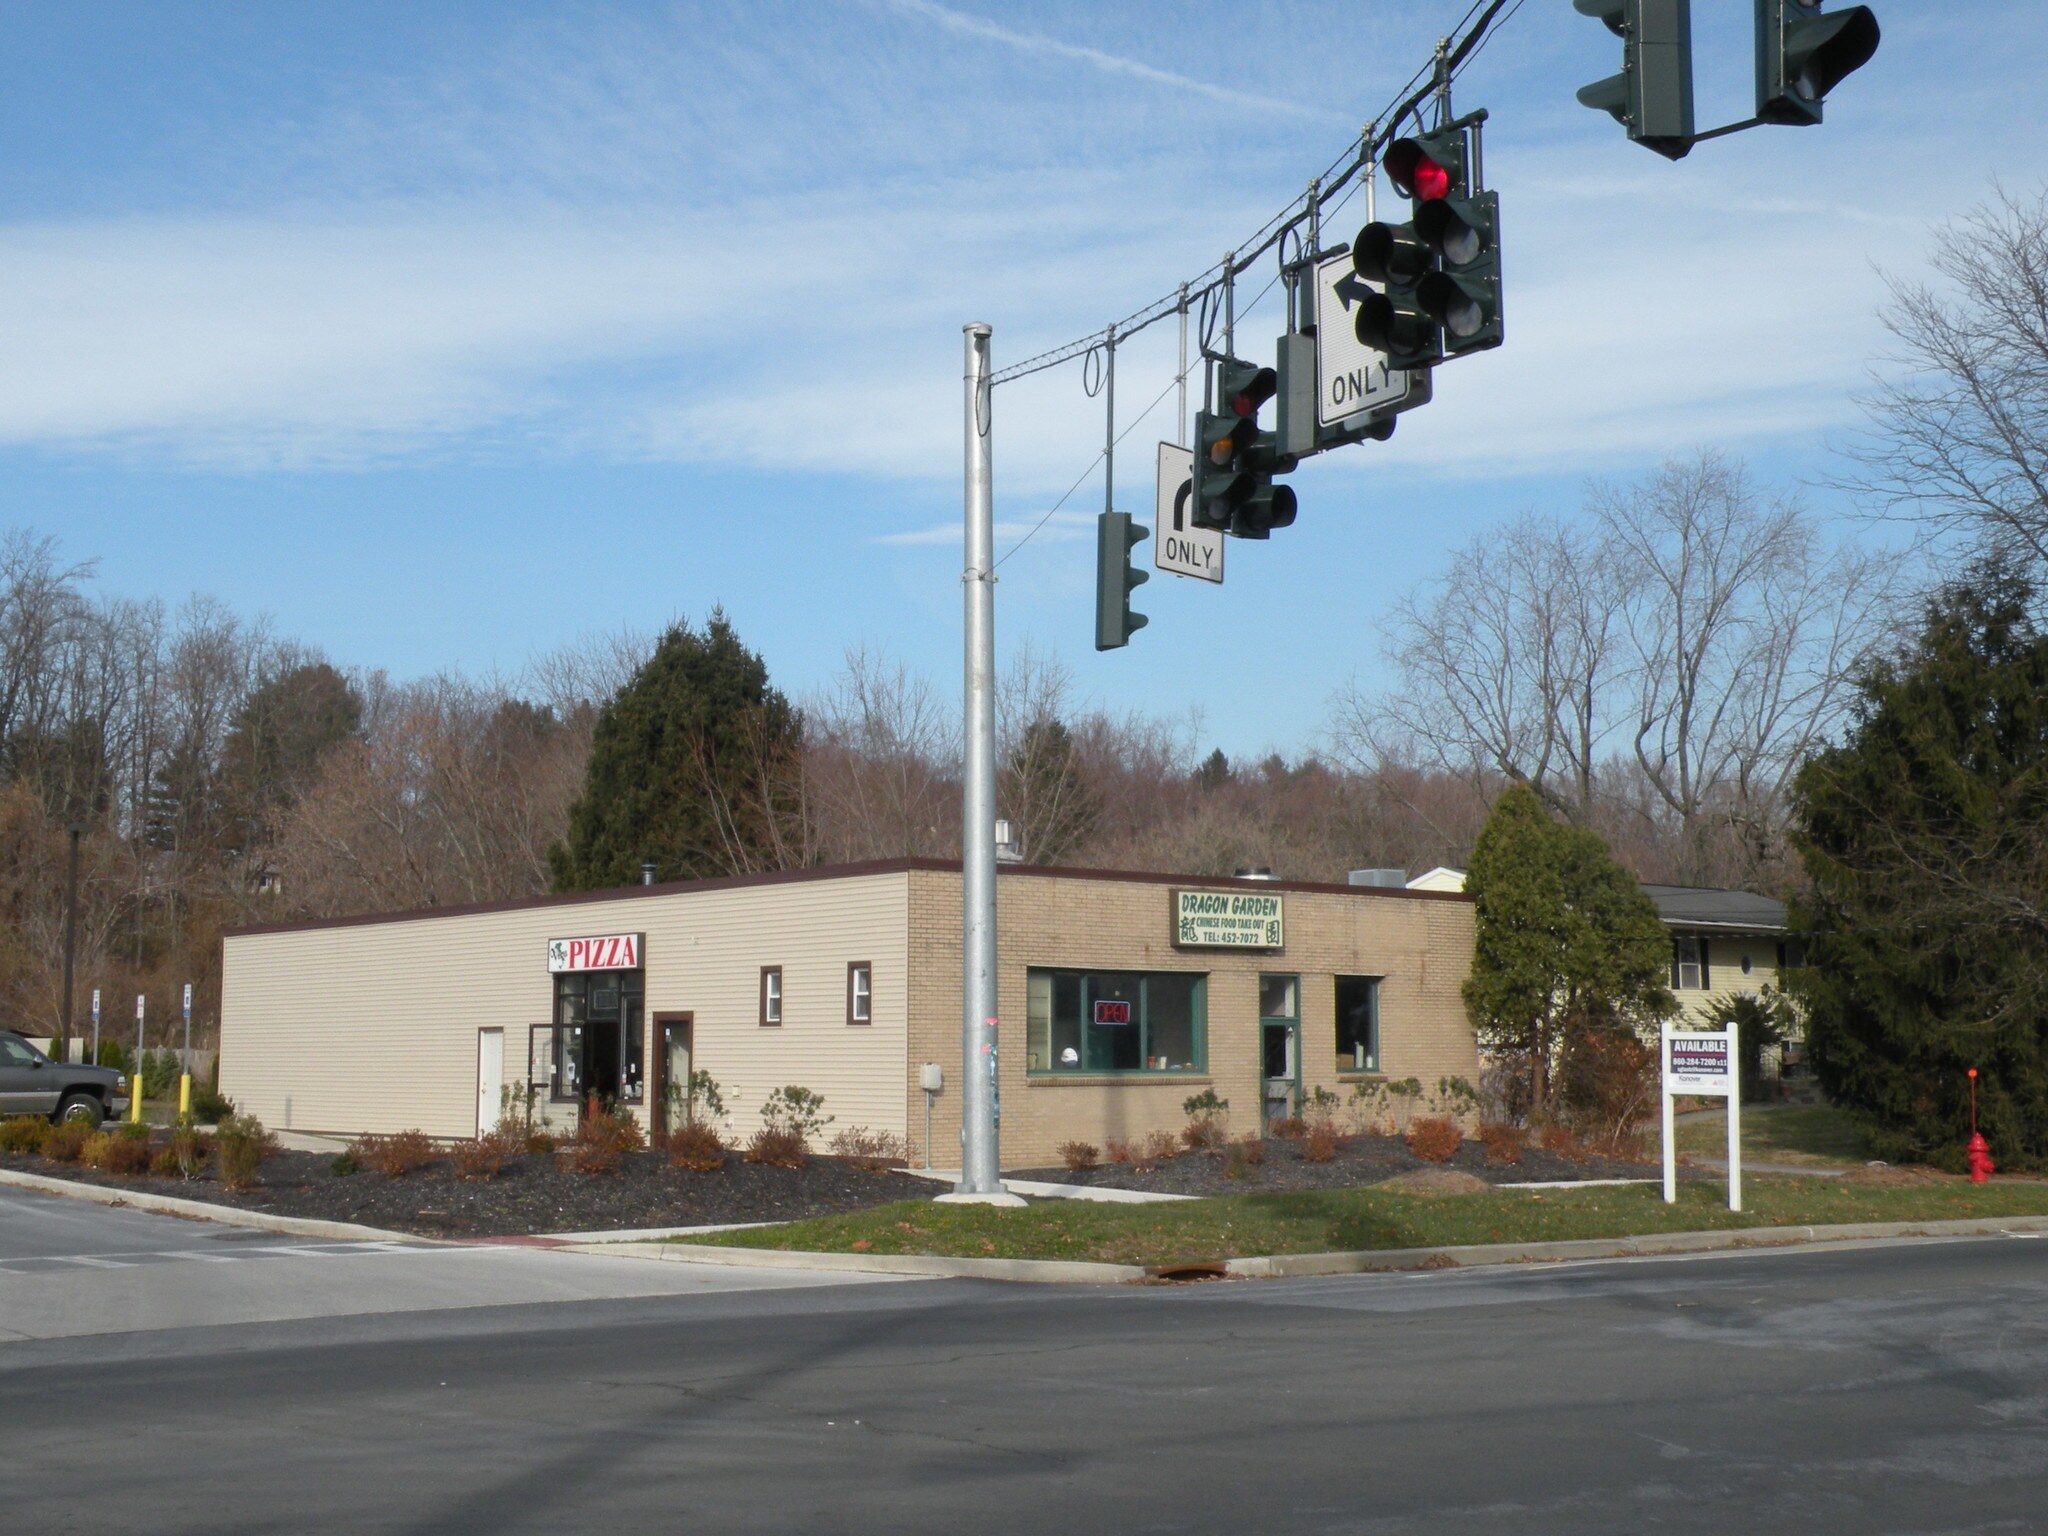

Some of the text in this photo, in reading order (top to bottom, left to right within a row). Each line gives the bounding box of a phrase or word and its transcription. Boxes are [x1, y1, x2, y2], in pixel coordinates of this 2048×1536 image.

[1332, 360, 1391, 405] ONLY
[1166, 537, 1214, 569] ONLY
[1182, 894, 1278, 916] DRAGON GARDEN
[1197, 916, 1264, 929] CHINESE FOOD TAKE OUT
[1204, 932, 1259, 944] TEL: 452-7072
[569, 936, 635, 969] PIZZA
[1097, 1003, 1129, 1022] OPEN
[1674, 1040, 1726, 1052] AVAILABLE
